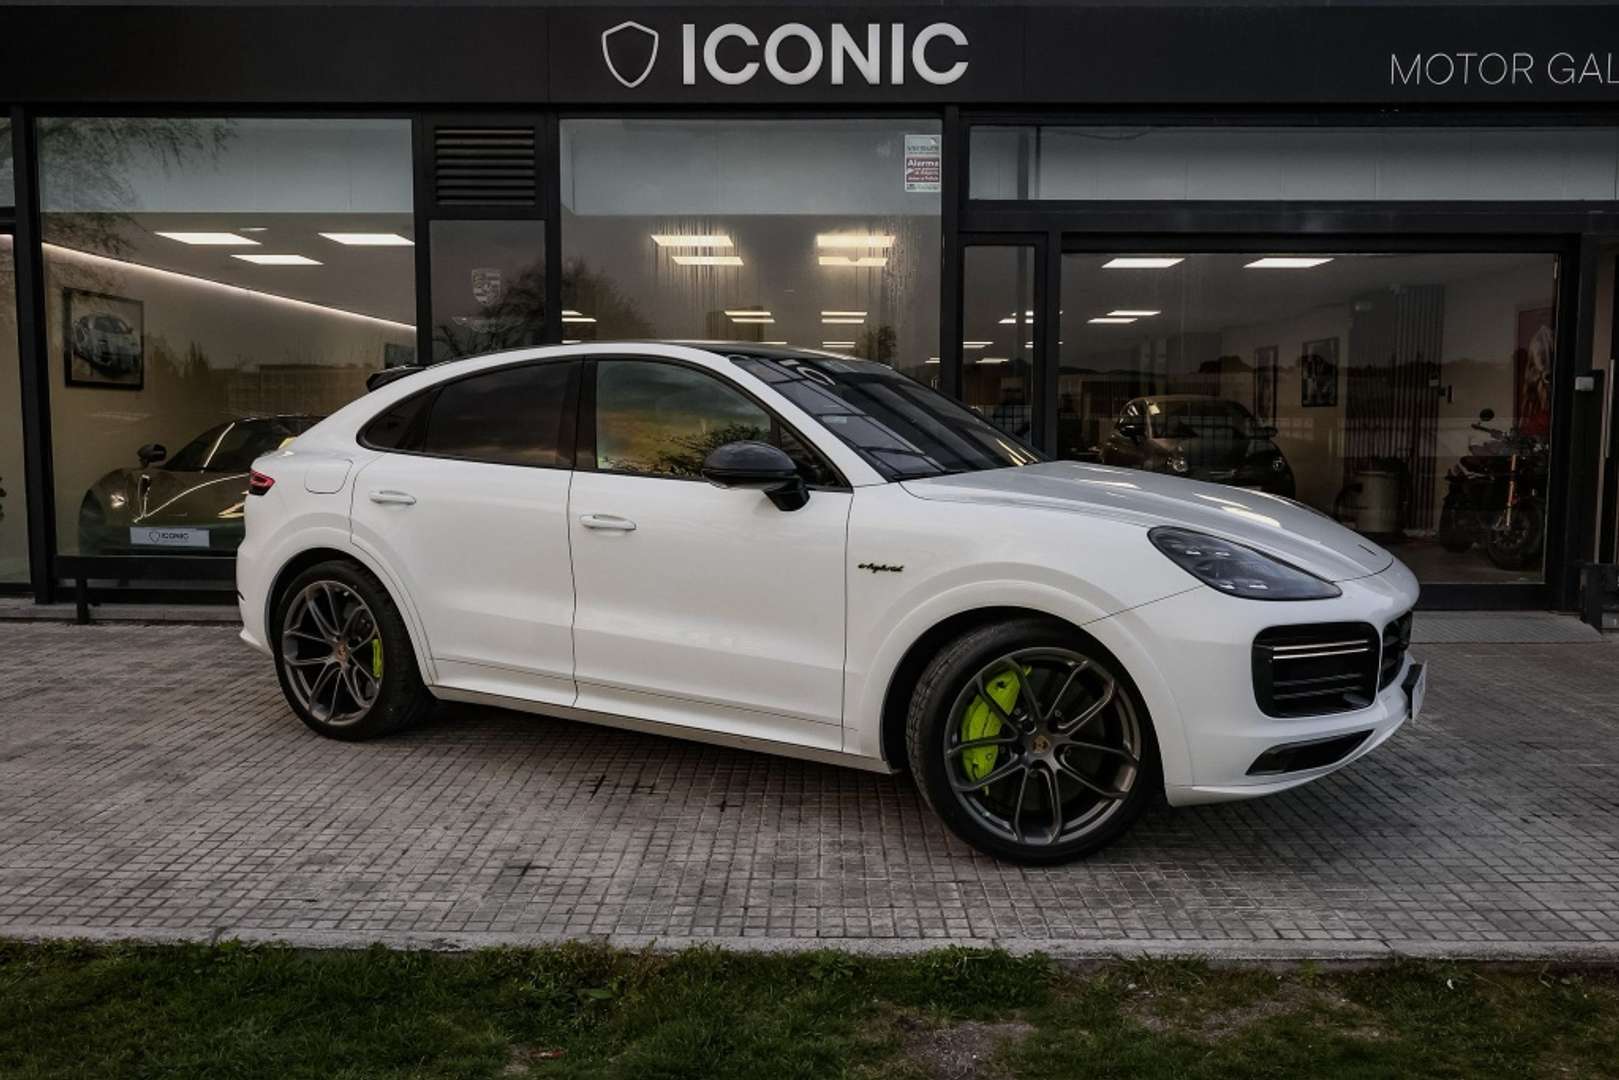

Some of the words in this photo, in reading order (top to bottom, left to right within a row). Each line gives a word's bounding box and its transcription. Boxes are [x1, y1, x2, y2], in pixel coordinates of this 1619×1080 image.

[682, 22, 969, 86] ICONIC
[1391, 52, 1535, 85] MOTOR
[907, 159, 939, 167] Alarma
[161, 532, 190, 540] ICONIC
